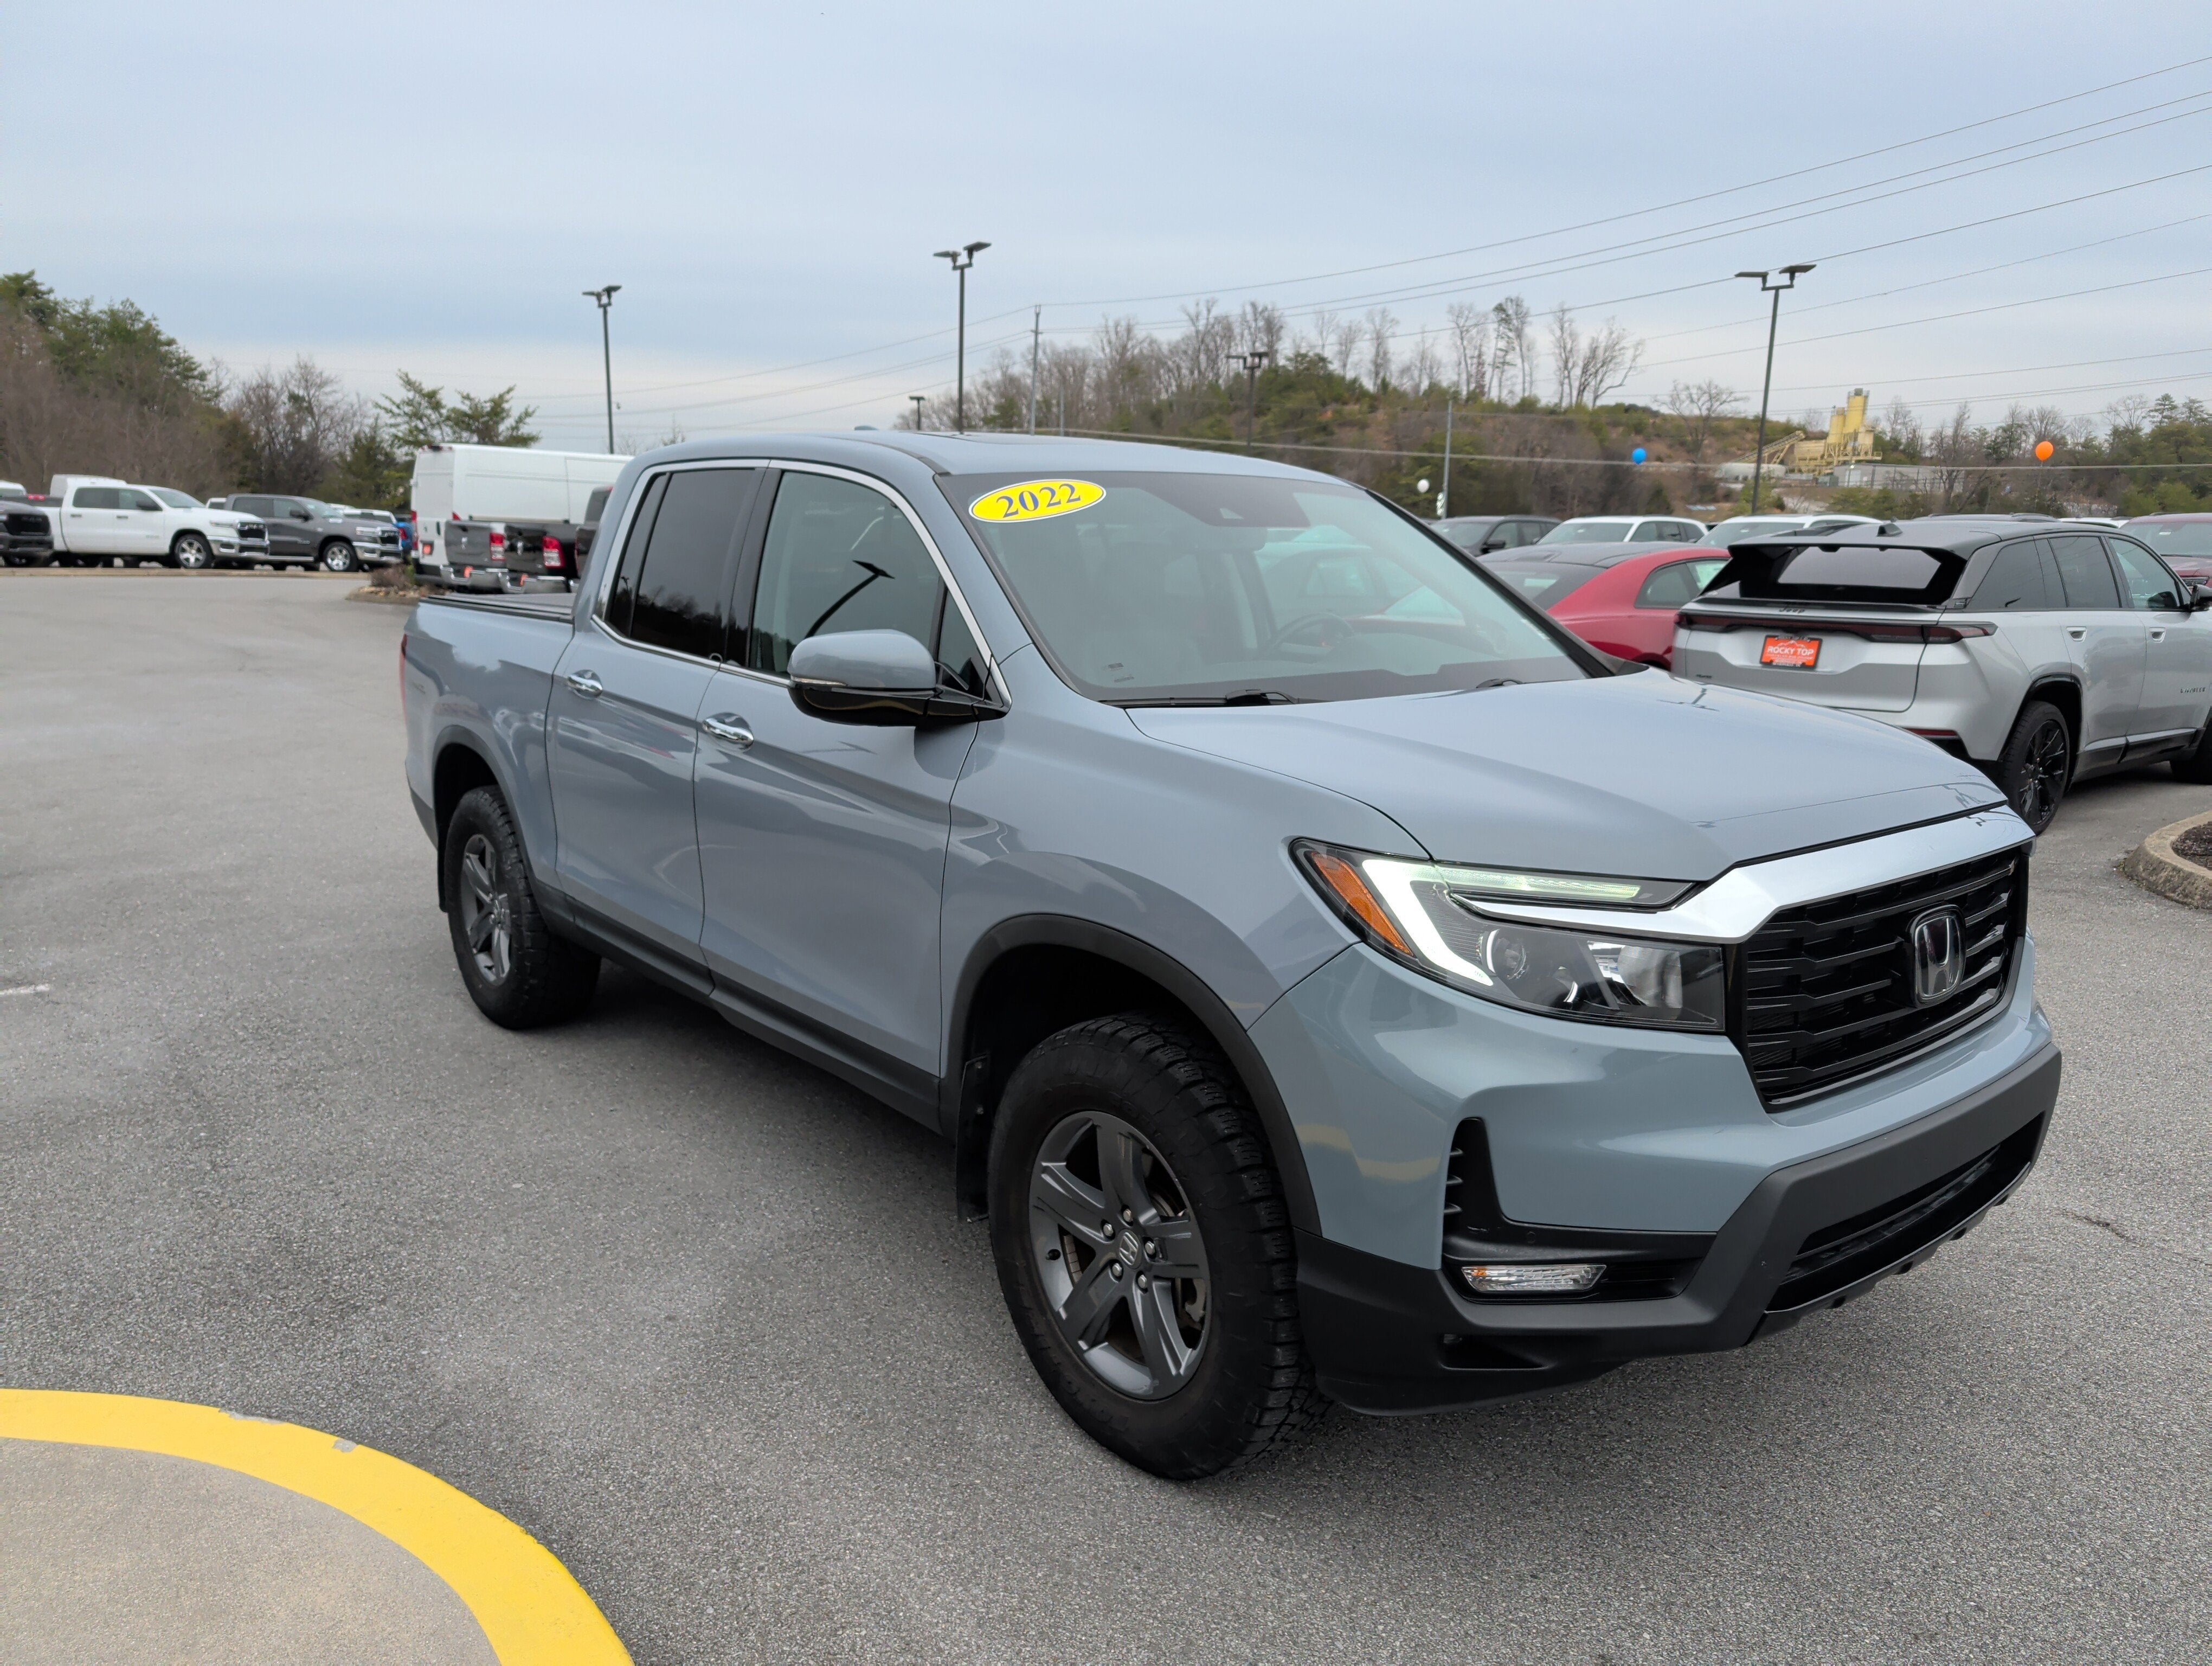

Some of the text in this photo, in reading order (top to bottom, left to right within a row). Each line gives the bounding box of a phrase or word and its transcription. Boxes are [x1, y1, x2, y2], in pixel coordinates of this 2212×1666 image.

[996, 483, 1081, 518] 2022
[1767, 645, 1814, 656] ROCKY TOP
